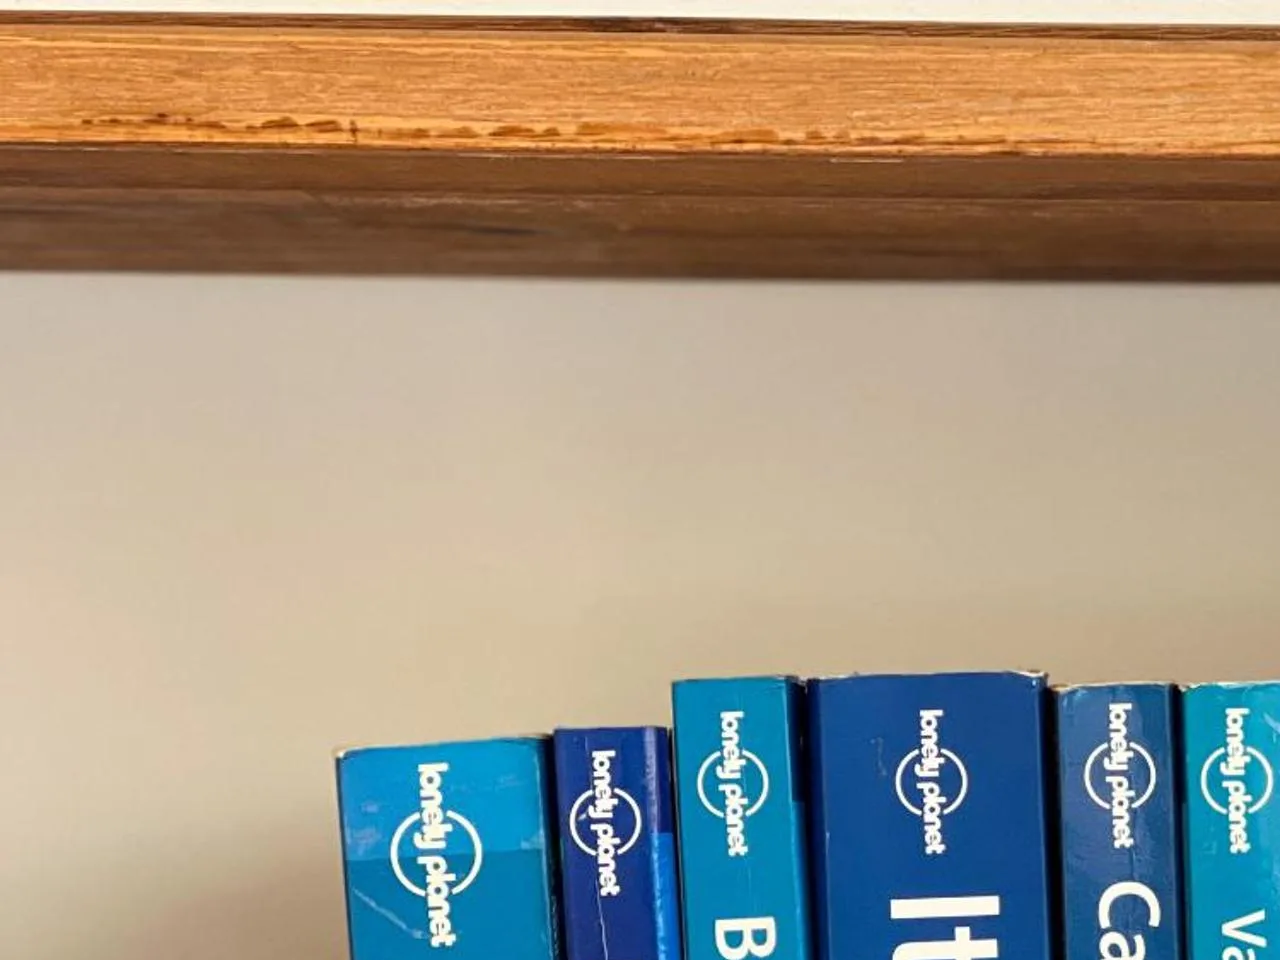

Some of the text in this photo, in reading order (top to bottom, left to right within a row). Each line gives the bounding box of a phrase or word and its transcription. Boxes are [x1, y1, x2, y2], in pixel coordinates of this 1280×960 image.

[589, 750, 623, 897] lonely planet
[719, 711, 749, 857] lonely planet
[917, 708, 946, 855] lonely planet
[1106, 701, 1134, 849] lonely planet
[1223, 707, 1251, 854] lonely planet
[413, 764, 456, 948] lonely planet
